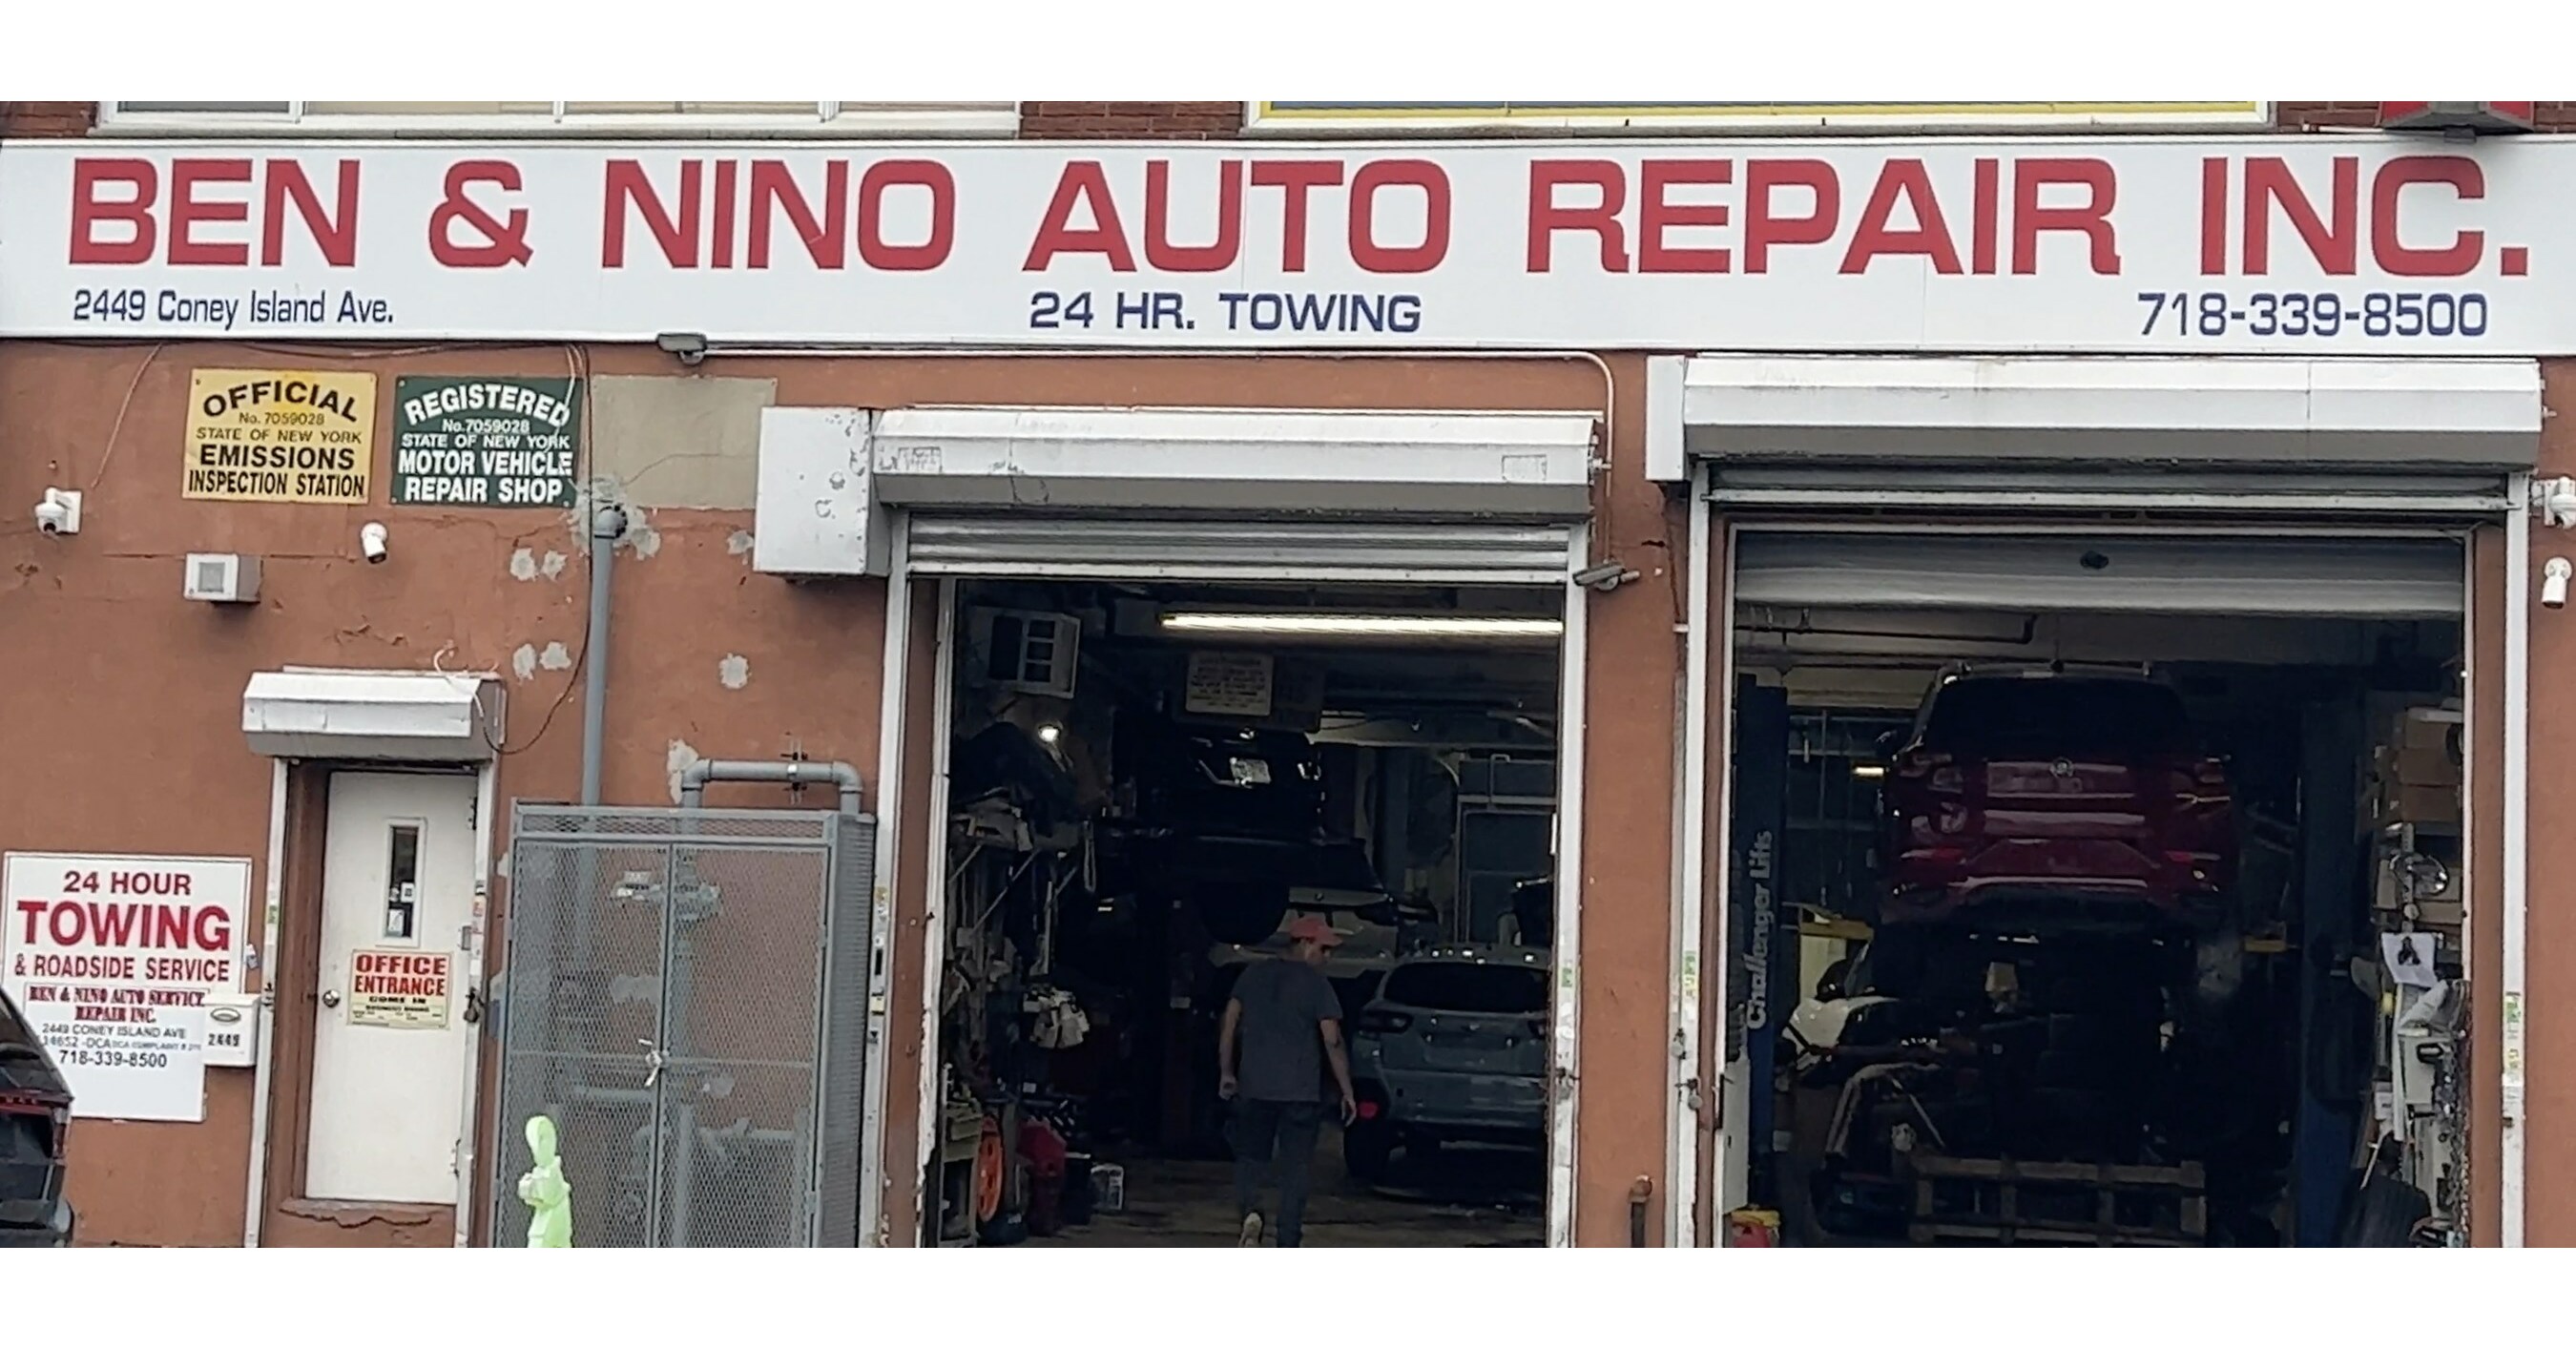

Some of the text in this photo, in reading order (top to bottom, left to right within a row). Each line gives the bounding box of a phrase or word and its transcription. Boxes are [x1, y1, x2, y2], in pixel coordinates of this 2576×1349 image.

[69, 155, 2529, 278] BEN & NINO AUTO REPAIR INC.
[73, 288, 394, 330] 2449 Coney Island Ave.
[1029, 291, 1422, 333] 24 HR. TOWING
[2137, 292, 2488, 337] 718-339-8500
[203, 380, 357, 423] OFFICIAL
[404, 384, 571, 427] REGISTERED
[239, 411, 325, 425] No. 7059028
[197, 426, 362, 445] STATE OF NEW YORK
[402, 433, 571, 449] STATE OF NEW YORK
[199, 444, 355, 470] EMISSIONS
[398, 448, 573, 476] MOTOR VEHICLE
[189, 469, 364, 497] INSPECTION STATION
[404, 477, 563, 503] REPAIR SHOP
[63, 870, 192, 896] 24 HOUR
[16, 900, 231, 951] TOWING
[1744, 830, 1776, 1030] Challenger Lifts
[14, 952, 230, 982] & ROADSIDE SERVICE
[356, 954, 447, 976] OFFICE
[354, 975, 447, 997] ENTRANCE
[74, 1006, 127, 1022] REPAIR
[72, 1024, 114, 1037] CONEY
[116, 1026, 160, 1039] ISLAND
[162, 1027, 186, 1040] AVE
[58, 1049, 168, 1069] 718-339-8500
